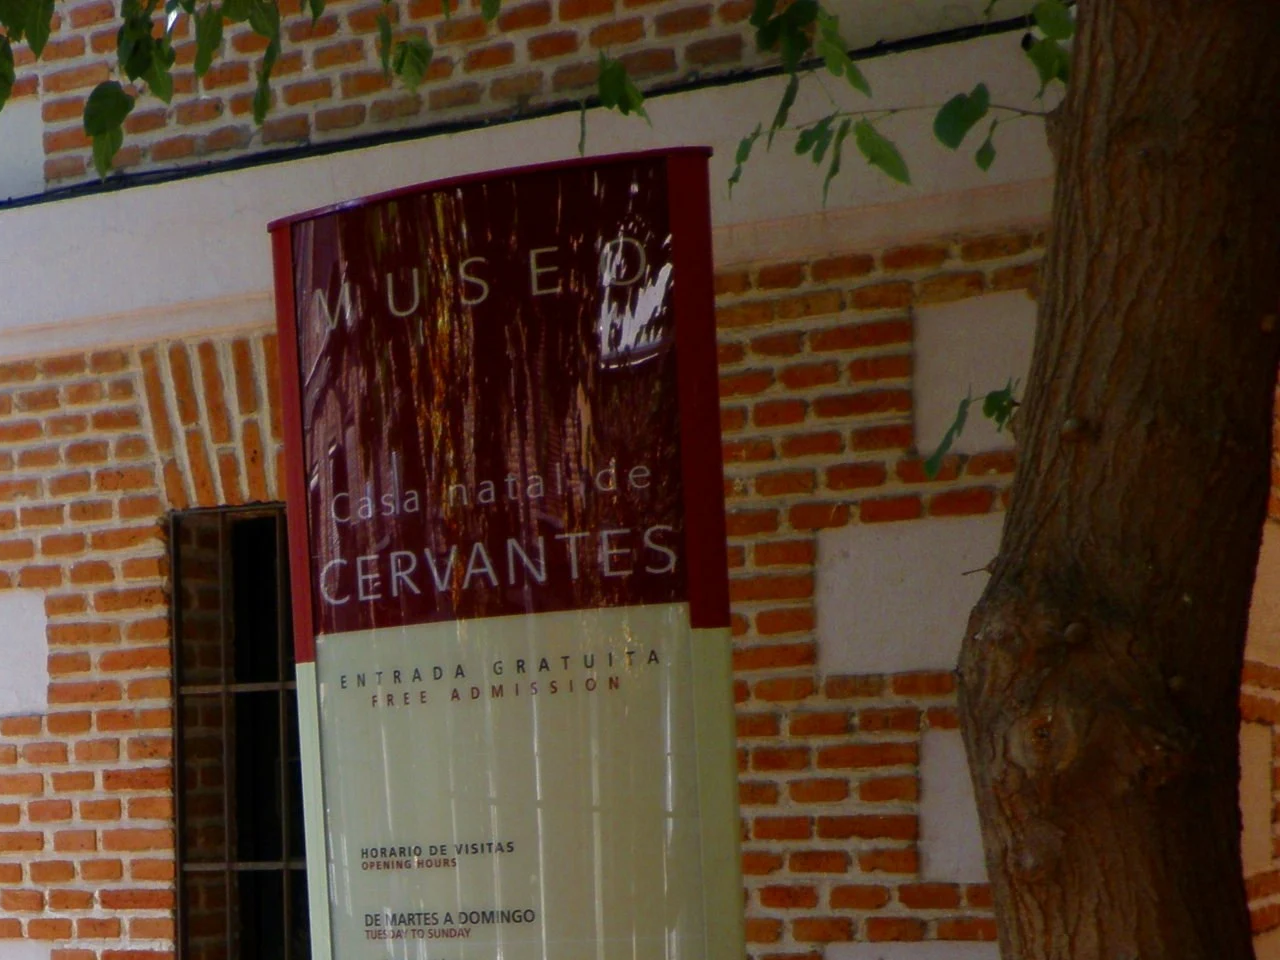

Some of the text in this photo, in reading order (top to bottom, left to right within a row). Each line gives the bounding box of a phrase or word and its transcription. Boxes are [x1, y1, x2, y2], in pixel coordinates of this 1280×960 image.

[314, 236, 648, 332] MUSEO
[331, 457, 653, 525] Casa natal de
[320, 524, 678, 607] CERVANTES
[339, 648, 661, 691] ENTRADA GRATUITA
[370, 676, 621, 709] FREE ADMISSION
[360, 841, 516, 860] HORARIO DE VISITAS
[361, 857, 458, 871] OPENING HOURS
[364, 908, 536, 928] DE MARTES A DOMINGO
[364, 927, 472, 941] TUESDAY TO SUNDAY
